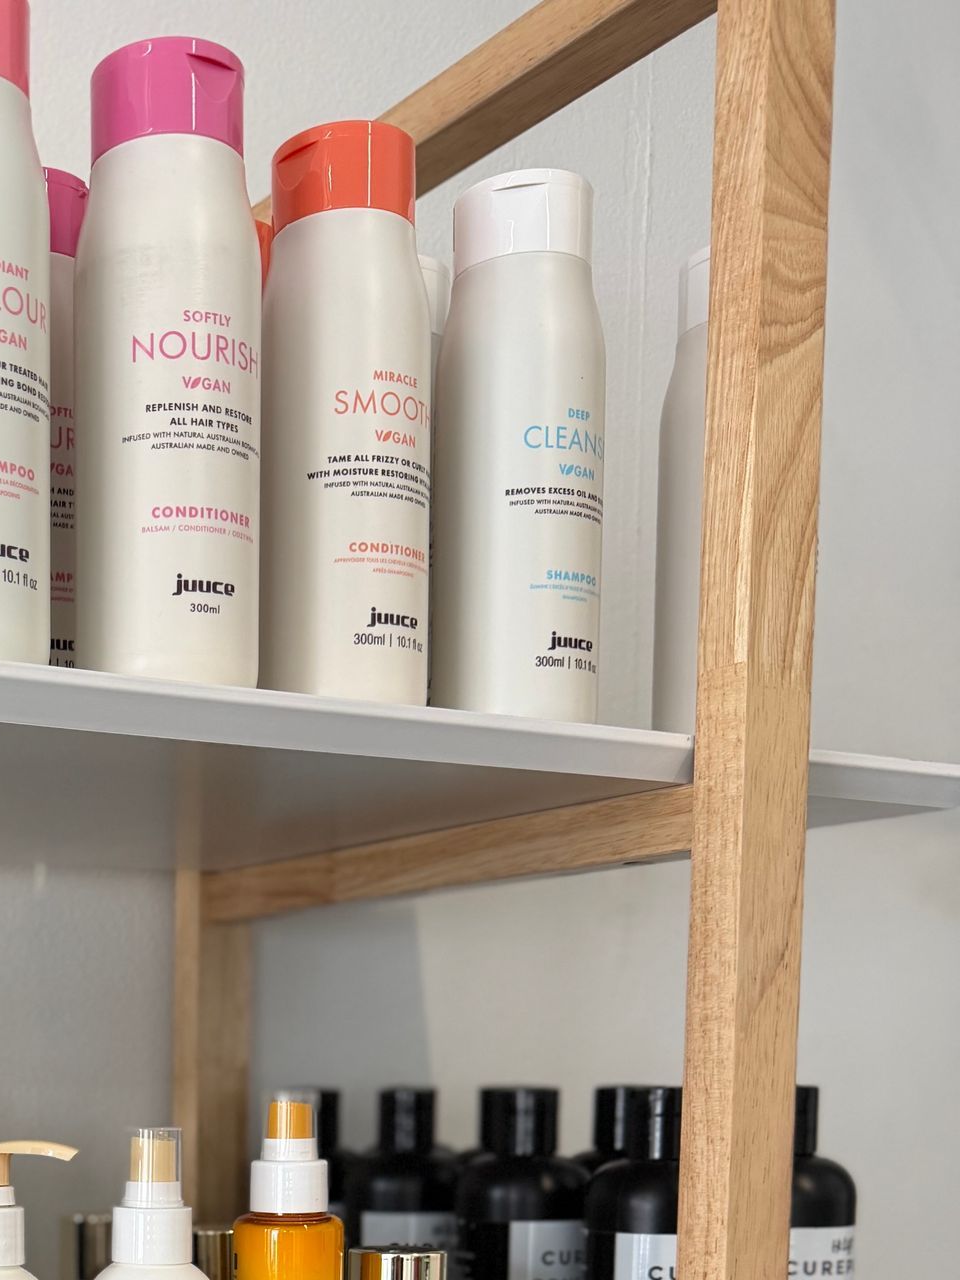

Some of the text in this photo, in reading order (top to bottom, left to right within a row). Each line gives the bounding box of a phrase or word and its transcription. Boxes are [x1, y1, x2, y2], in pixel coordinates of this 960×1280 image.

[182, 309, 232, 328] SOFTLY
[131, 330, 259, 381] NOURISH
[8, 362, 38, 385] TREATED
[372, 369, 419, 389] MIRACLE
[144, 402, 253, 425] REPLENISH AND RESTORE
[567, 407, 591, 421] DEEP
[168, 417, 239, 433] ALL HAIR TYPES
[121, 431, 242, 446] INFUSED WITH NATURAL AUSTRALIAN
[523, 424, 605, 464] CLEANS
[327, 453, 412, 469] TAME ALL FRIZZY OR
[306, 467, 420, 486] WITH MOISTURE RESTORING
[504, 486, 576, 498] REMOVES EXCESS
[150, 505, 252, 530] CONDITIONER
[171, 572, 236, 598] juuce
[189, 602, 222, 615] 300ml
[366, 606, 420, 630] juuce
[352, 632, 386, 648] 300ml
[546, 630, 594, 653] juuce
